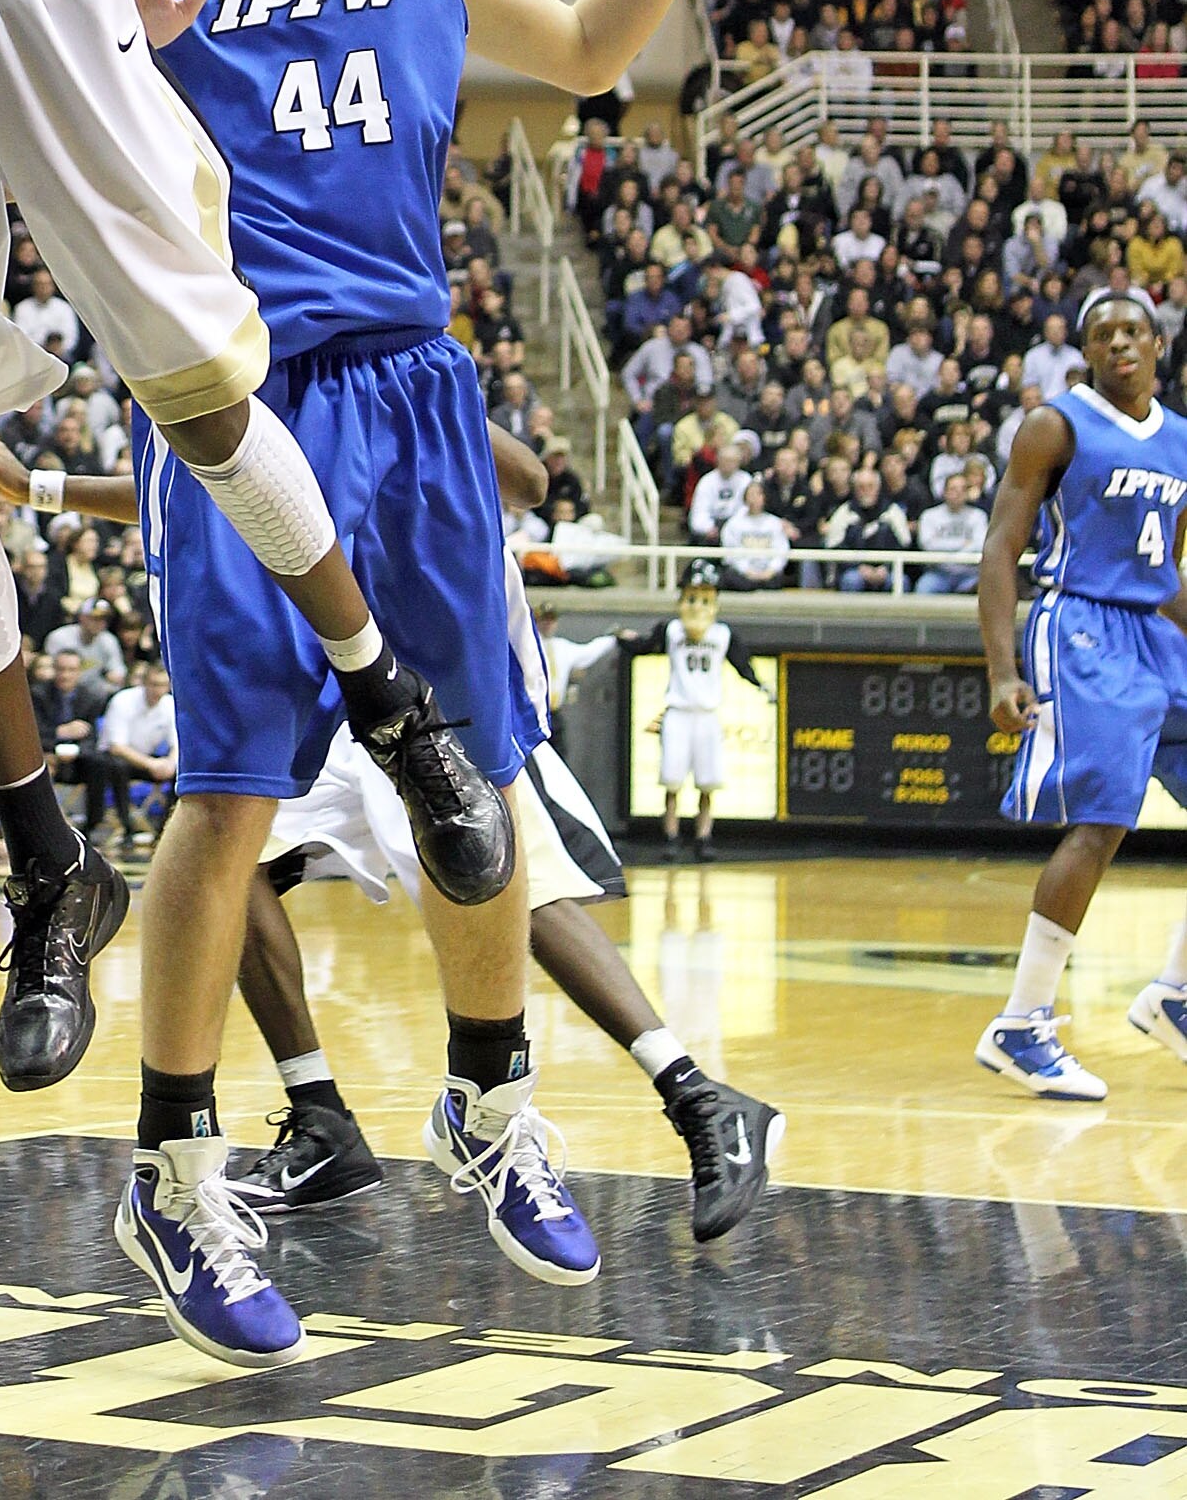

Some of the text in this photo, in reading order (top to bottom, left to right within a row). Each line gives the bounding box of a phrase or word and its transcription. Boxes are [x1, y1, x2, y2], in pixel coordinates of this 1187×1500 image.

[272, 48, 393, 152] 44
[1103, 468, 1187, 506] IPFW
[1137, 511, 1164, 567] 4
[793, 728, 854, 750] HOME
[892, 733, 951, 753] PERIOD
